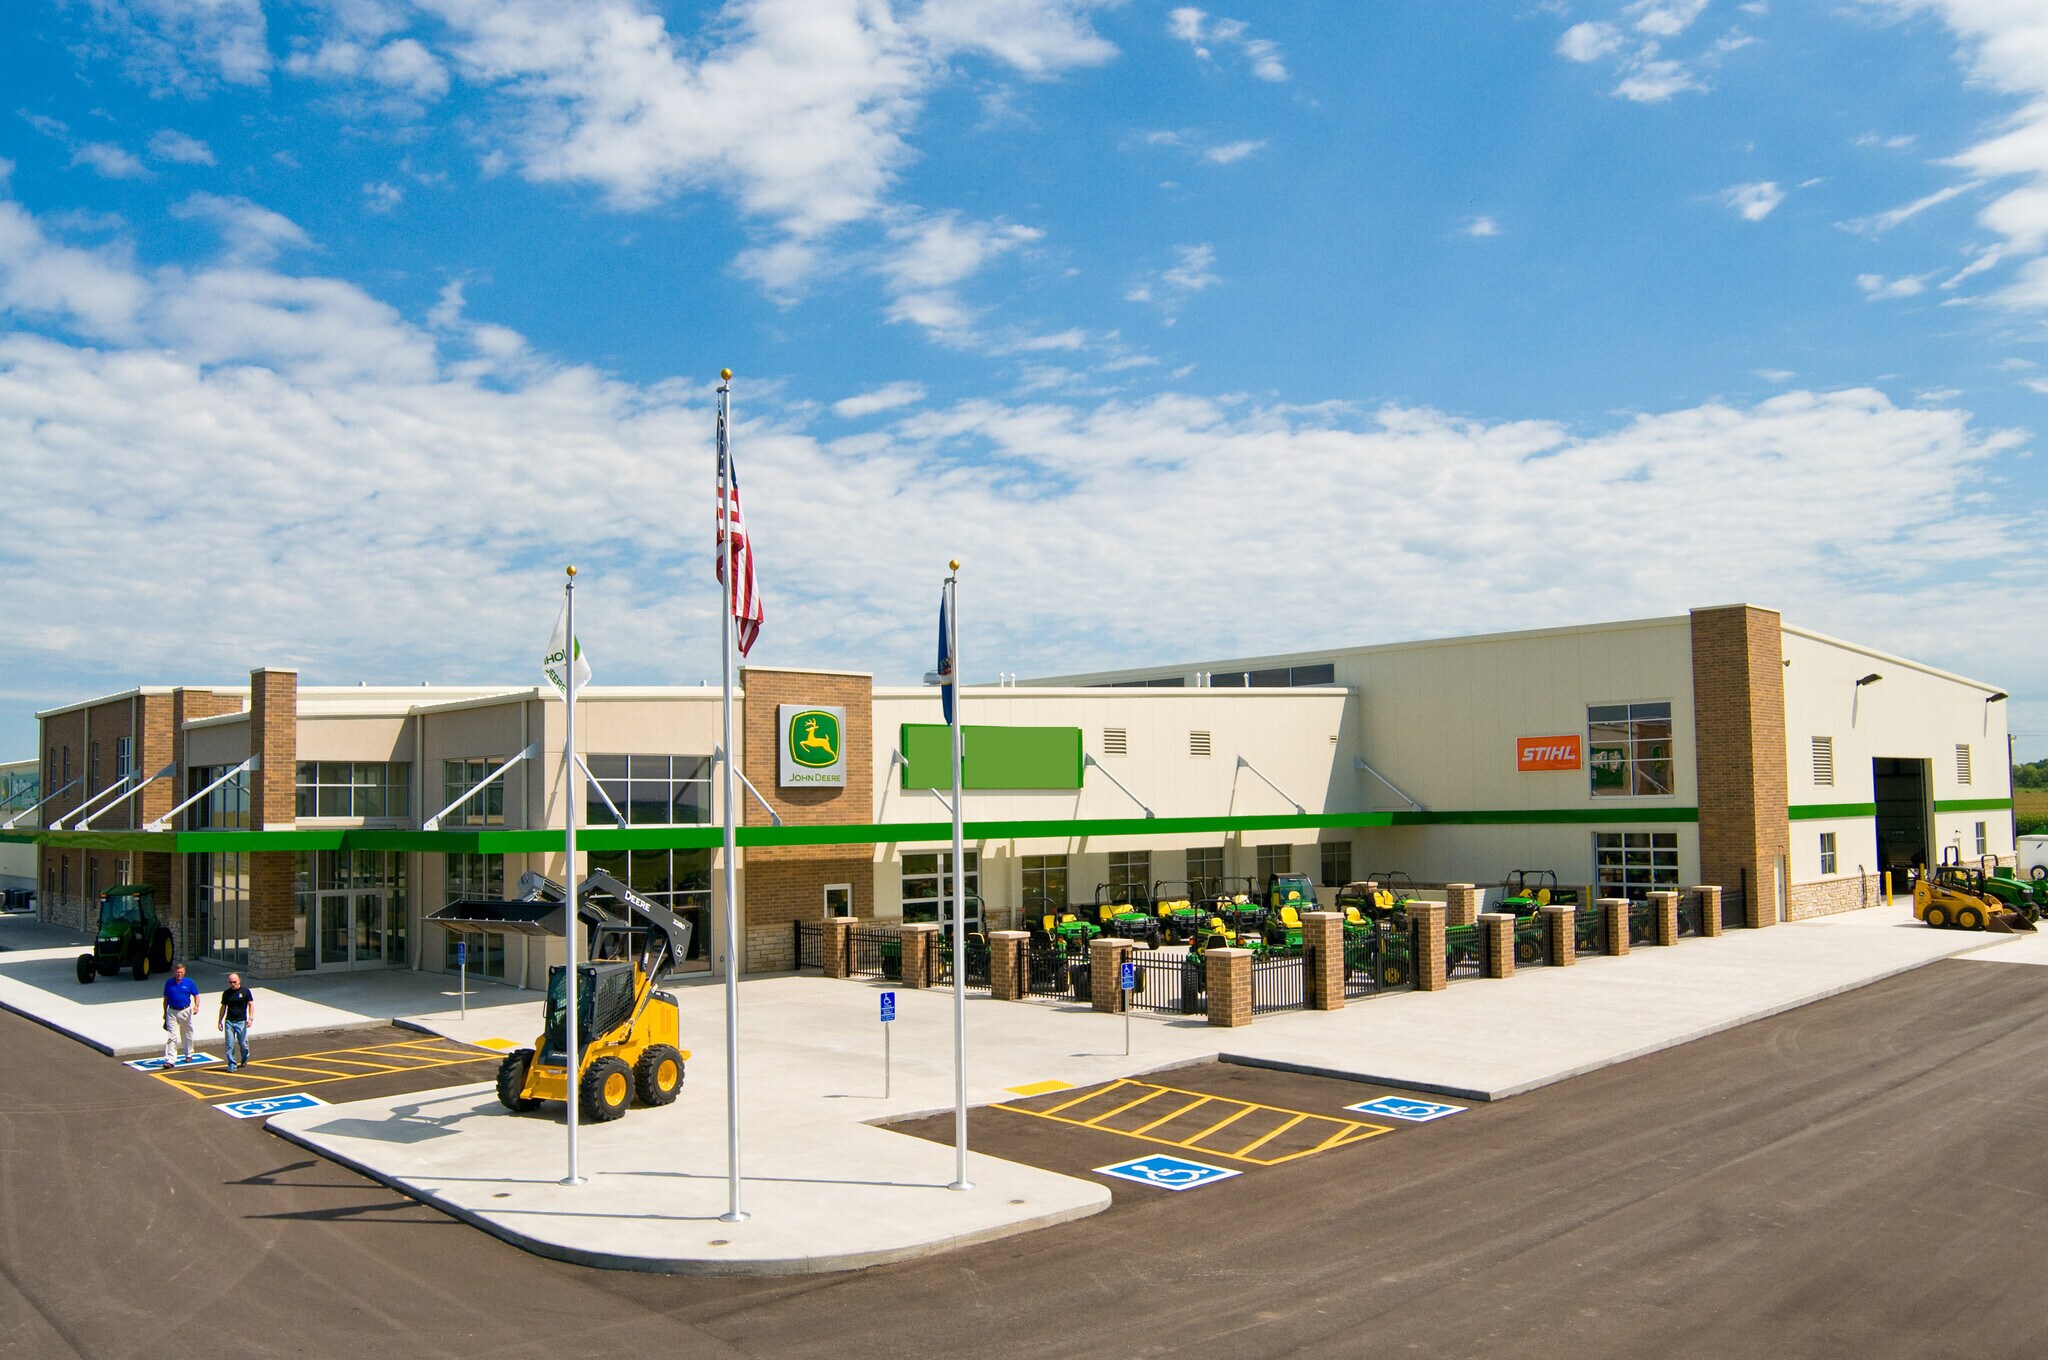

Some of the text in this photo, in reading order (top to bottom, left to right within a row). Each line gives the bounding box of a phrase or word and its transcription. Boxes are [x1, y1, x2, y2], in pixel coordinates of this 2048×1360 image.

[1521, 745, 1576, 761] STIHL
[789, 773, 841, 782] JOHN DEERE
[624, 889, 651, 912] DEERE
